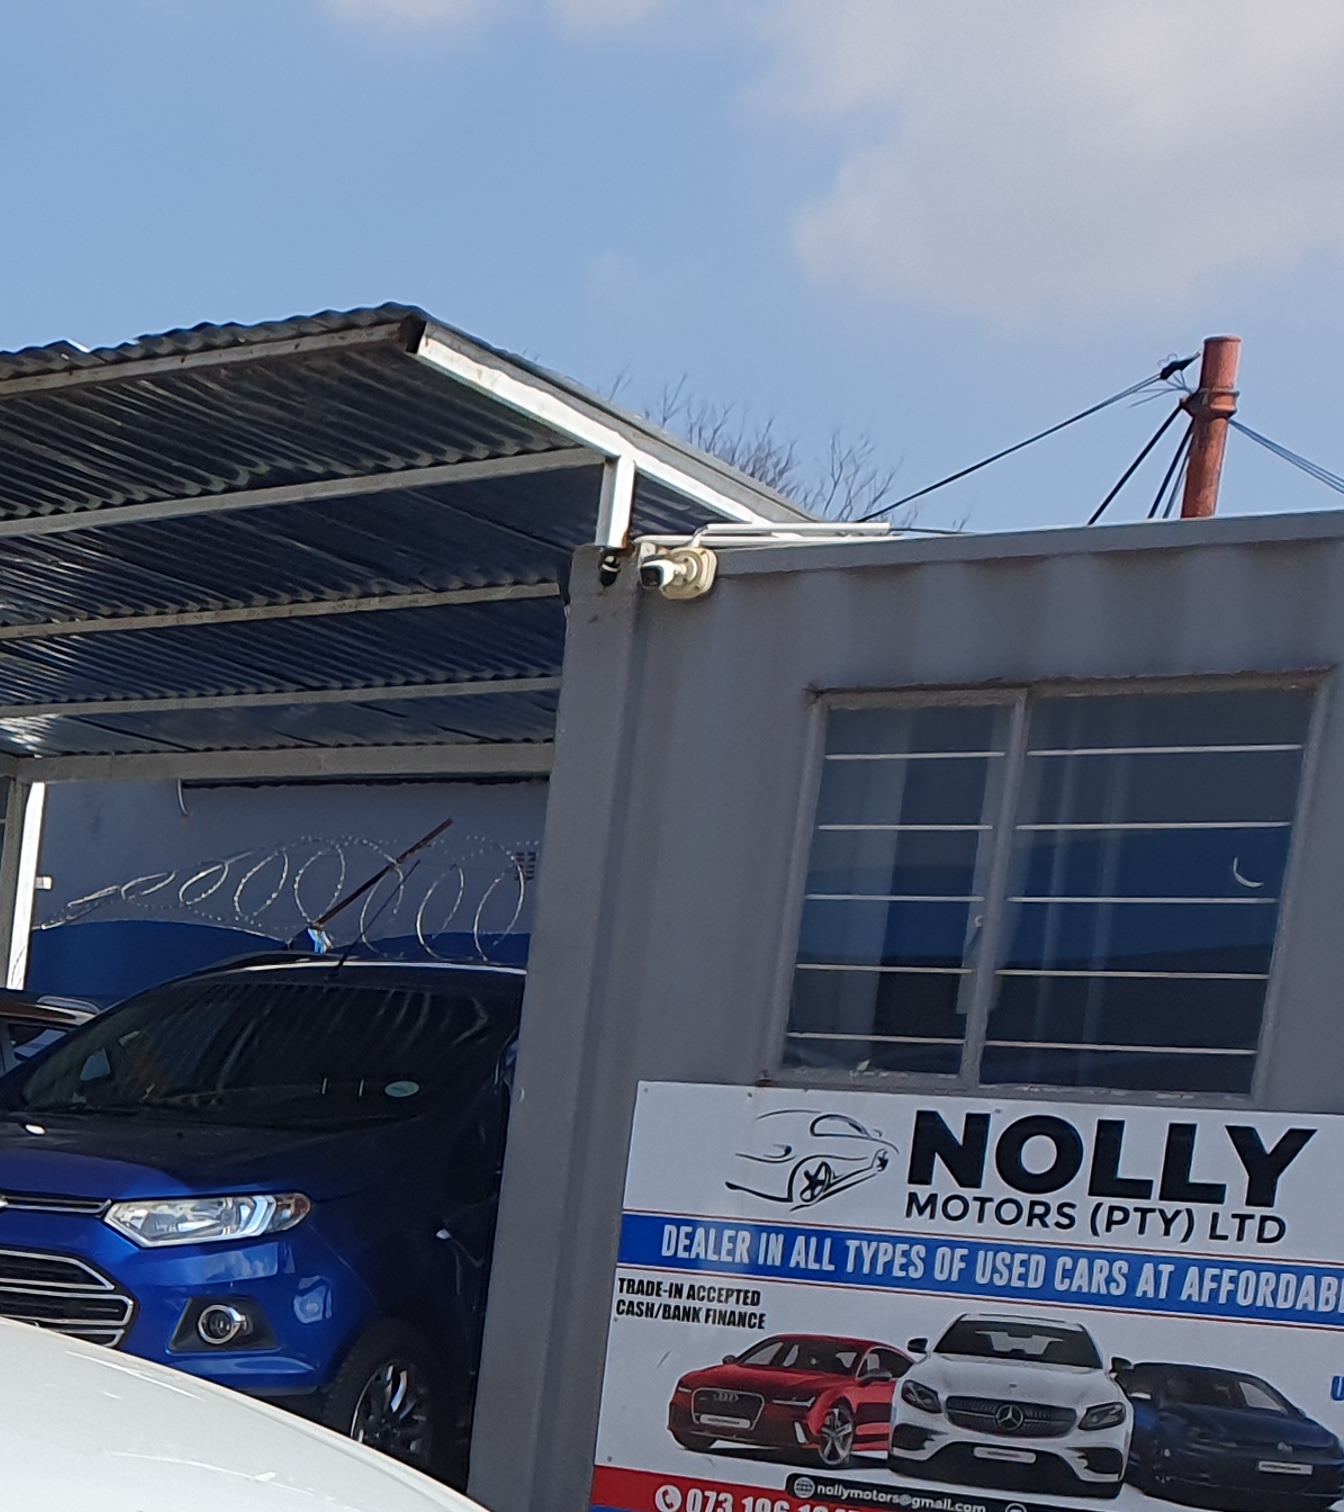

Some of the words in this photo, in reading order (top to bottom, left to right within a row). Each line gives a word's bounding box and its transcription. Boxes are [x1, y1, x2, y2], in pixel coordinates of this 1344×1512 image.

[908, 1110, 1318, 1207] NOLLY
[905, 1191, 1076, 1229] MOTORS
[1090, 1202, 1195, 1243] (PTY)
[1209, 1212, 1287, 1243] LTD
[662, 1224, 750, 1263] DEALER
[758, 1232, 784, 1266] IN
[790, 1235, 835, 1271] ALL
[845, 1240, 925, 1279] TYPES
[934, 1247, 968, 1282] OF
[975, 1250, 1046, 1288] USED
[1054, 1256, 1129, 1296] CARS
[1136, 1263, 1174, 1299] AT
[615, 1299, 701, 1324] CASH/BANK
[704, 1309, 766, 1330] FINANCE
[617, 1277, 684, 1300] TRADE-IN
[686, 1284, 761, 1307] ACCEPTED
